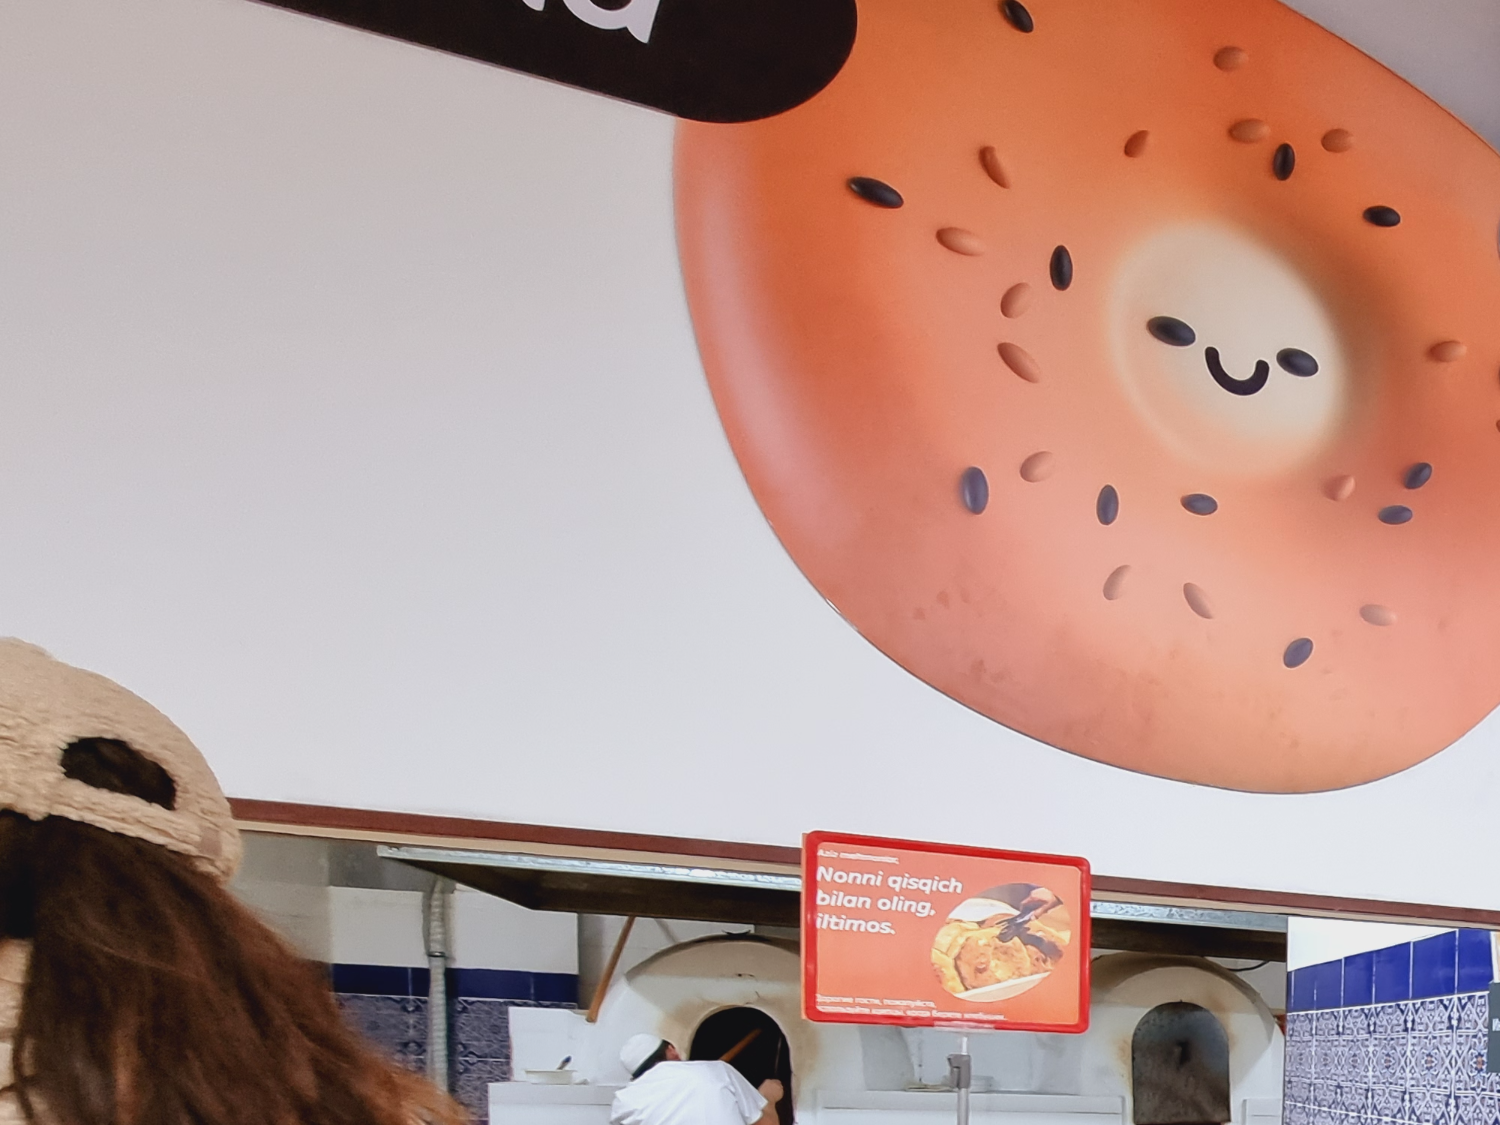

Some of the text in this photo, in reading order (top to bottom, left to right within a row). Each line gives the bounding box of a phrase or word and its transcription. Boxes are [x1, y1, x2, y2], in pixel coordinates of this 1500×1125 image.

[816, 866, 963, 895] Nonni qisqich
[816, 889, 936, 917] bilan oling,
[816, 913, 896, 935] iltimos.
